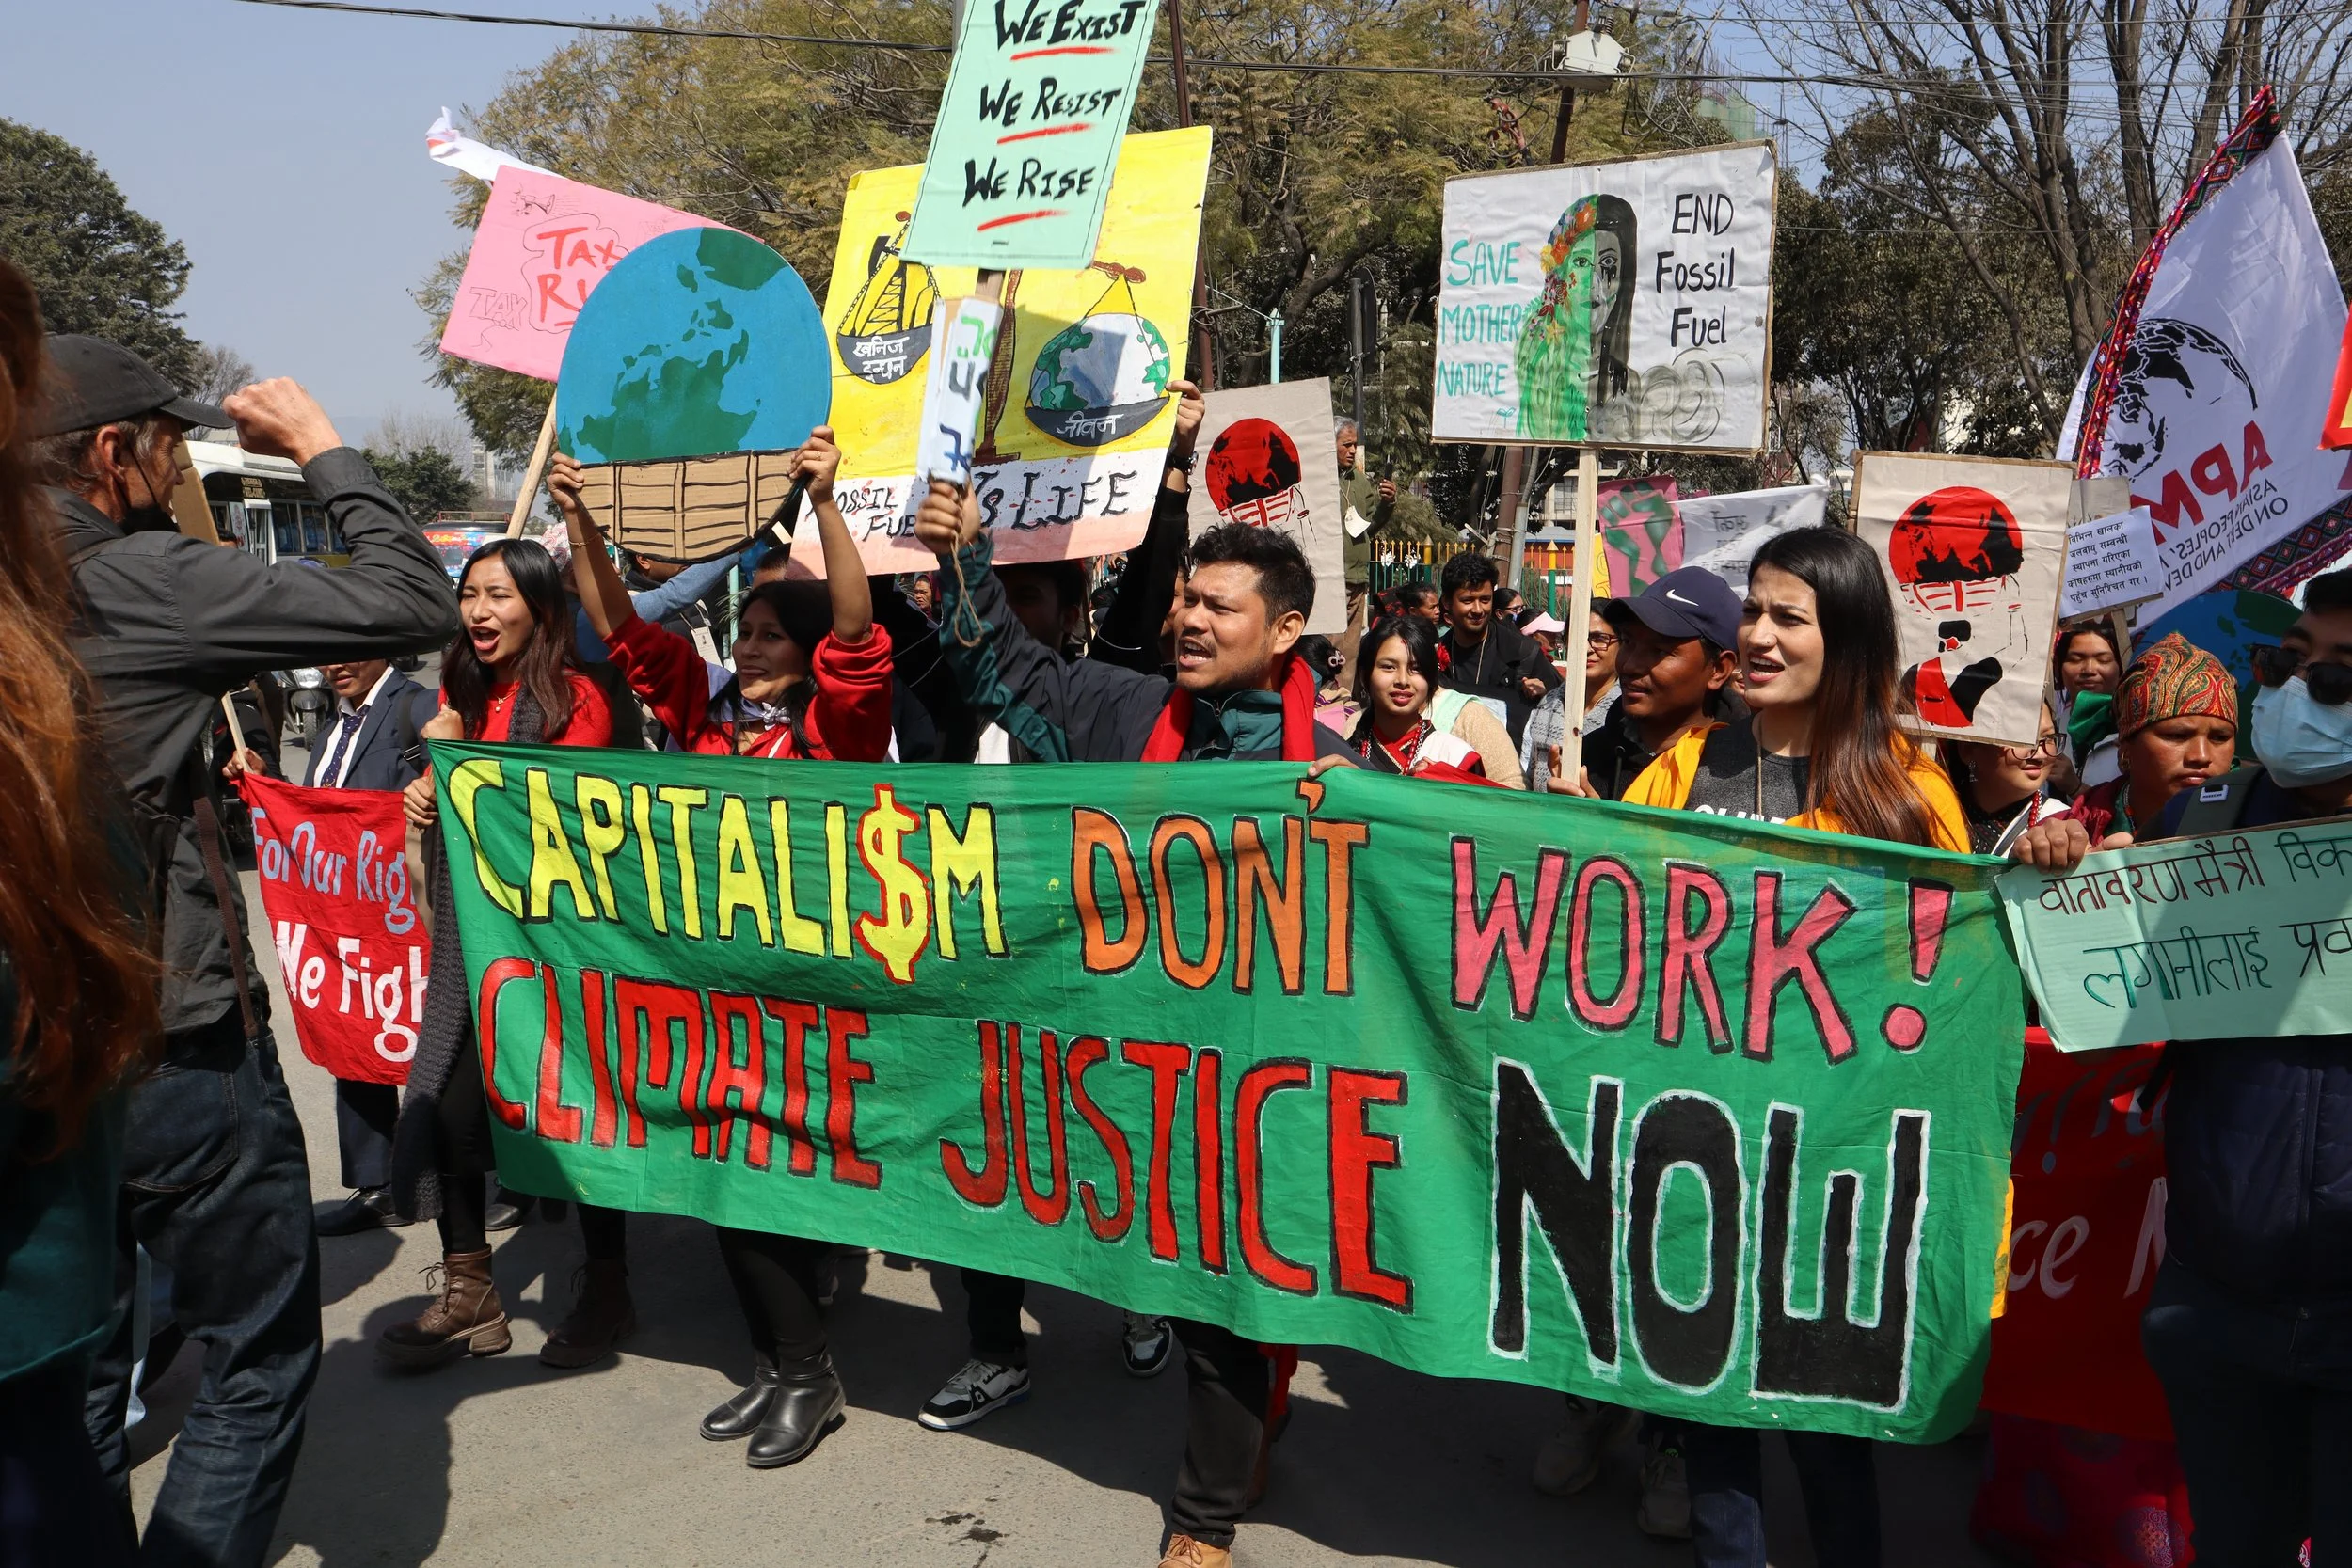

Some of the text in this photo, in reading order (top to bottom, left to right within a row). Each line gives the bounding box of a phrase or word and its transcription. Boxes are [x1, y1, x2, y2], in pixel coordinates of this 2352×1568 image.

[994, 0, 1146, 51] WE EXIST
[979, 76, 1122, 127] WE RESIST
[962, 156, 1096, 208] WE RISE
[1672, 193, 1734, 236] END
[536, 226, 623, 270] TAX
[1447, 239, 1521, 286] SAVE
[1656, 246, 1735, 293] Fossil
[537, 273, 588, 323] RI
[852, 336, 910, 357] खनिज
[1441, 303, 1523, 345] MOTHER
[1671, 305, 1727, 347] Fuel
[1437, 361, 1508, 398] NATURE
[1056, 411, 1125, 439] जीवन
[805, 486, 898, 517] OSSIL
[1011, 470, 1137, 531] LIFE
[862, 513, 916, 542] FUE
[291, 821, 347, 895] Our
[357, 830, 416, 934] Rig
[1070, 778, 1370, 996] DON'T
[274, 920, 428, 1062] We Figh
[478, 956, 882, 1189] CLIMATE
[941, 1020, 1413, 1316] JUSTICE
[1487, 1054, 1931, 1415] NOW
